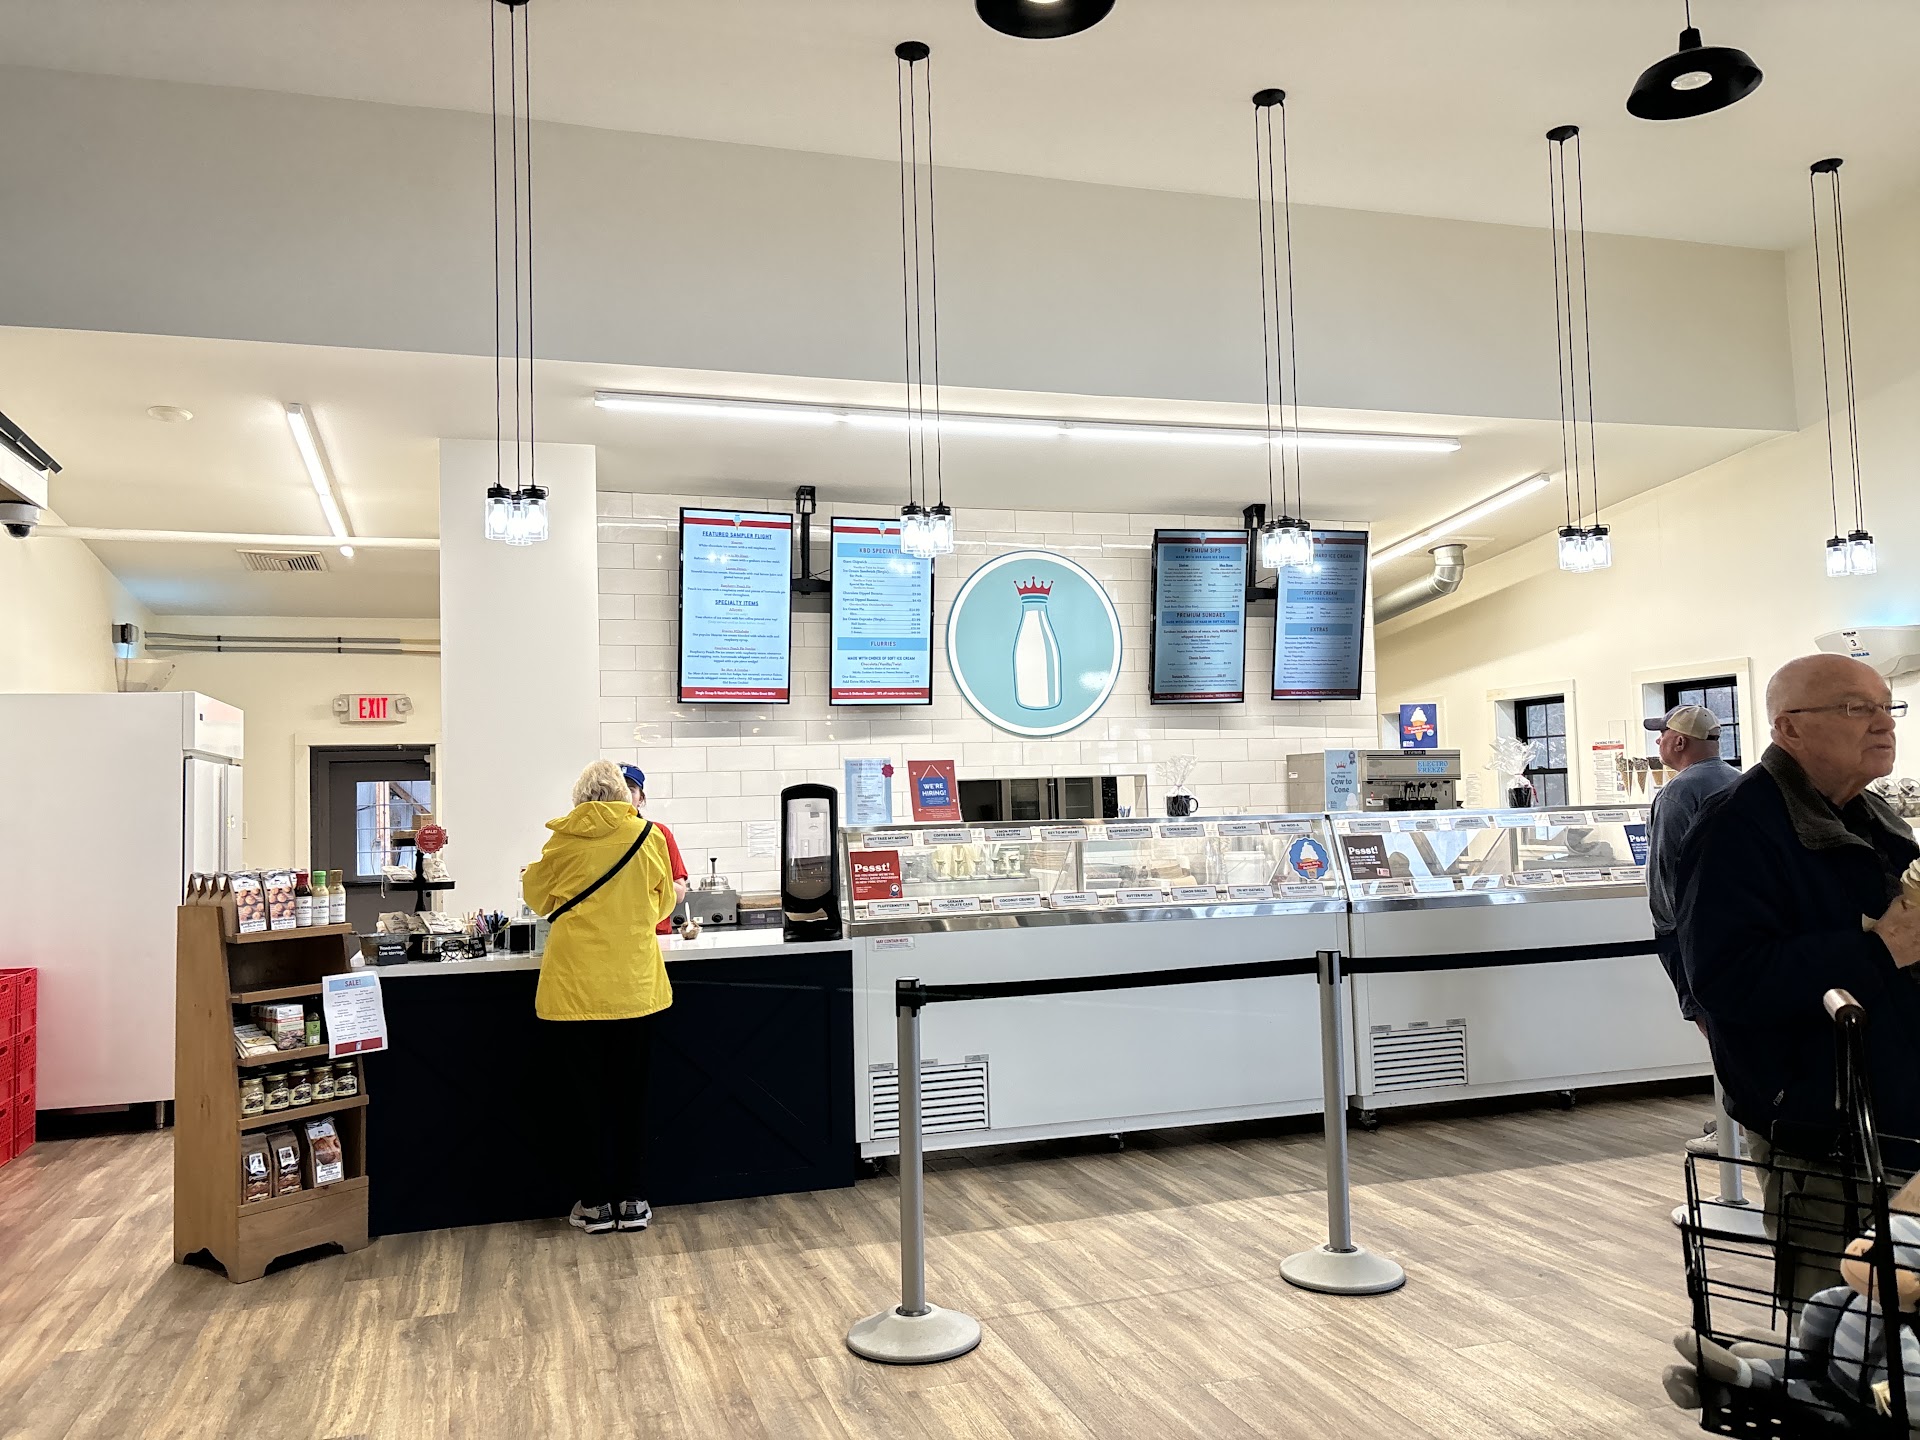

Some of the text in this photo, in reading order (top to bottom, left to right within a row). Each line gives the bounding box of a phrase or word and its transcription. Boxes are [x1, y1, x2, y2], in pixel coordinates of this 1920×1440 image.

[358, 697, 388, 719] EXIT
[1348, 846, 1378, 855] Pssst!
[854, 863, 890, 872] Pssst!
